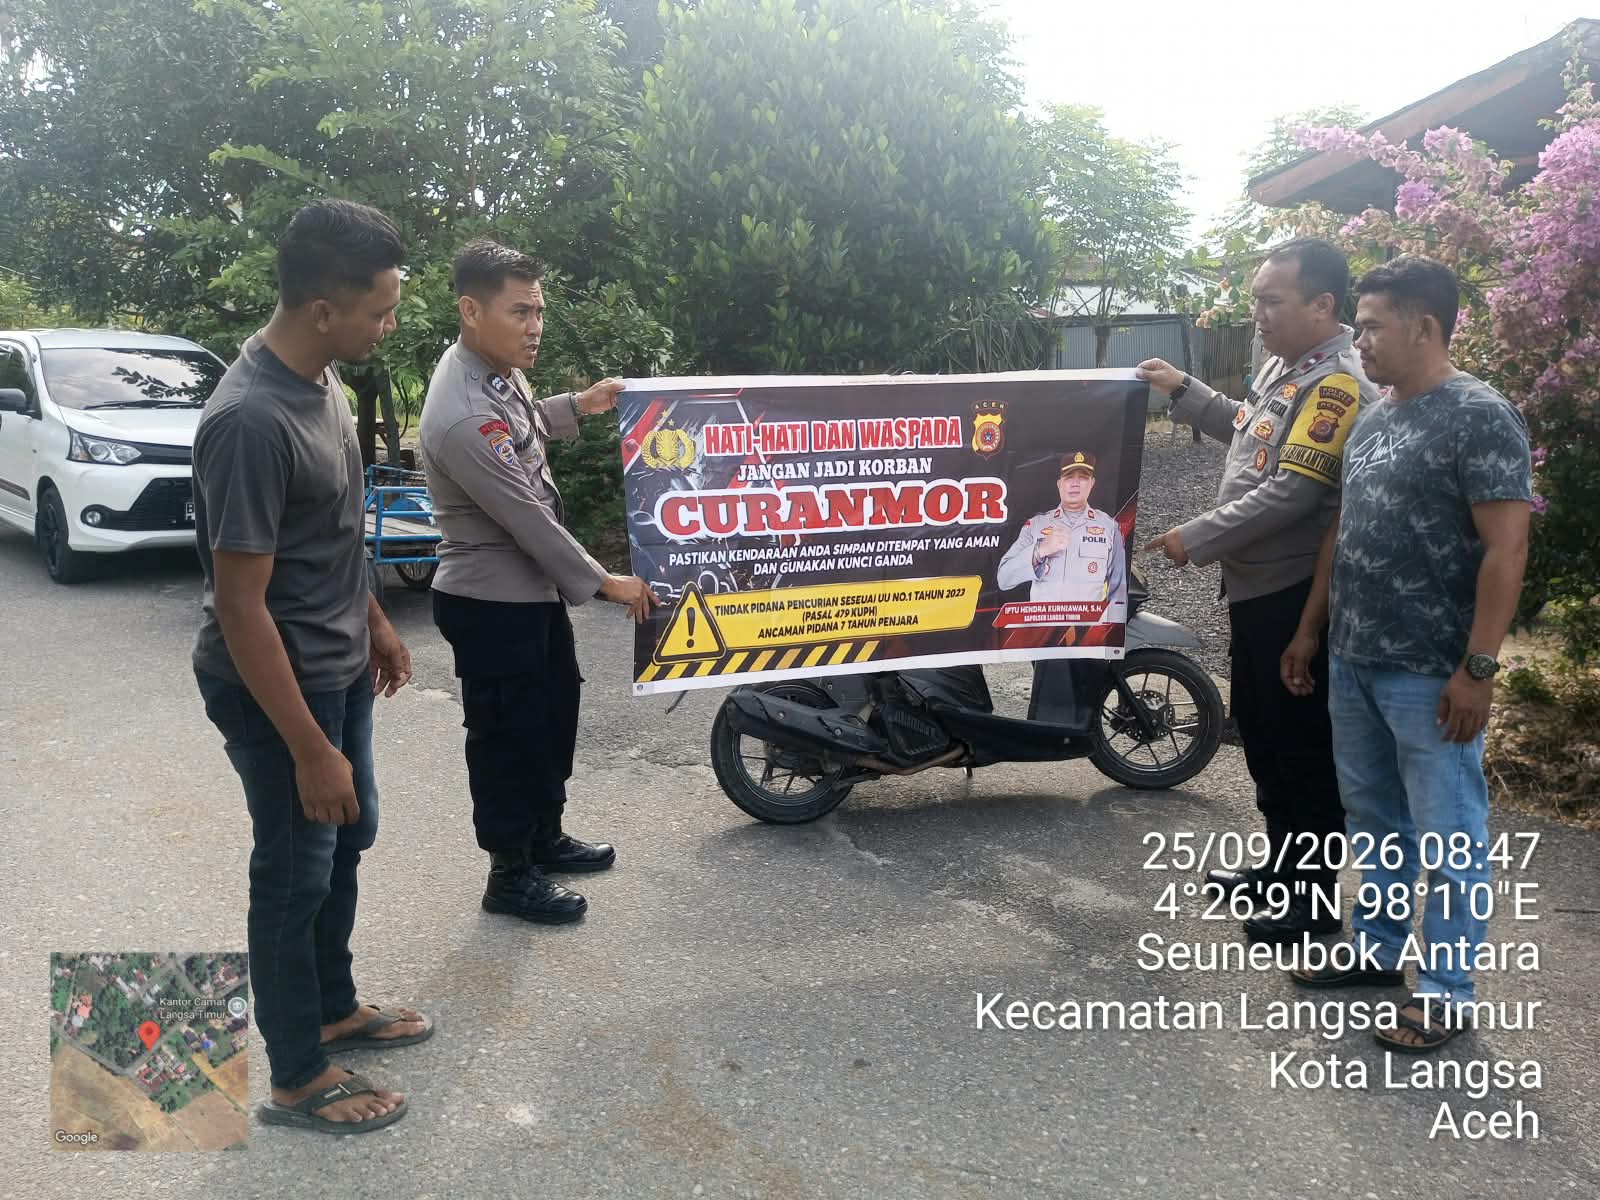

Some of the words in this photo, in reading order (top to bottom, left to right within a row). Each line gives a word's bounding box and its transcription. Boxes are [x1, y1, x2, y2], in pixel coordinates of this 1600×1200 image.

[704, 422, 809, 456] HATI-HATI
[812, 418, 857, 451] DAN
[859, 416, 963, 449] WASPADA
[738, 462, 810, 481] JANGAN
[814, 460, 855, 478] JADI
[859, 457, 933, 477] KORBAN
[658, 480, 1005, 537] CURANMOR
[669, 551, 727, 567] PASTIKAN
[728, 548, 798, 563] KENDARAAN
[800, 544, 831, 557] ANDA
[832, 542, 876, 556] SIMPAN
[877, 538, 931, 553] DITEMPAT
[933, 537, 963, 550] YANG
[965, 535, 1000, 548] AMAN
[1082, 536, 1107, 544] POLRI
[753, 562, 778, 576] DAN
[779, 559, 836, 573] GUNAKAN
[837, 556, 872, 569] KUNCI
[874, 553, 914, 566] GANDA
[715, 604, 750, 617] TINDAK
[751, 601, 785, 613] PIDANA
[787, 597, 839, 611] PENCURIAN
[840, 594, 877, 607] SESEUAI
[878, 592, 891, 603] UU
[892, 591, 912, 602] NO.1
[914, 589, 945, 601] TAHUN
[945, 588, 966, 599] 2023
[1020, 605, 1047, 614] HENDRA
[757, 625, 805, 639] ANCAMAN
[806, 620, 839, 634] PIDANA
[840, 620, 846, 630] 7
[847, 617, 877, 630] TAHUN
[878, 614, 919, 627] PENJARA
[802, 610, 833, 624] (PASAL
[834, 608, 850, 619] 479
